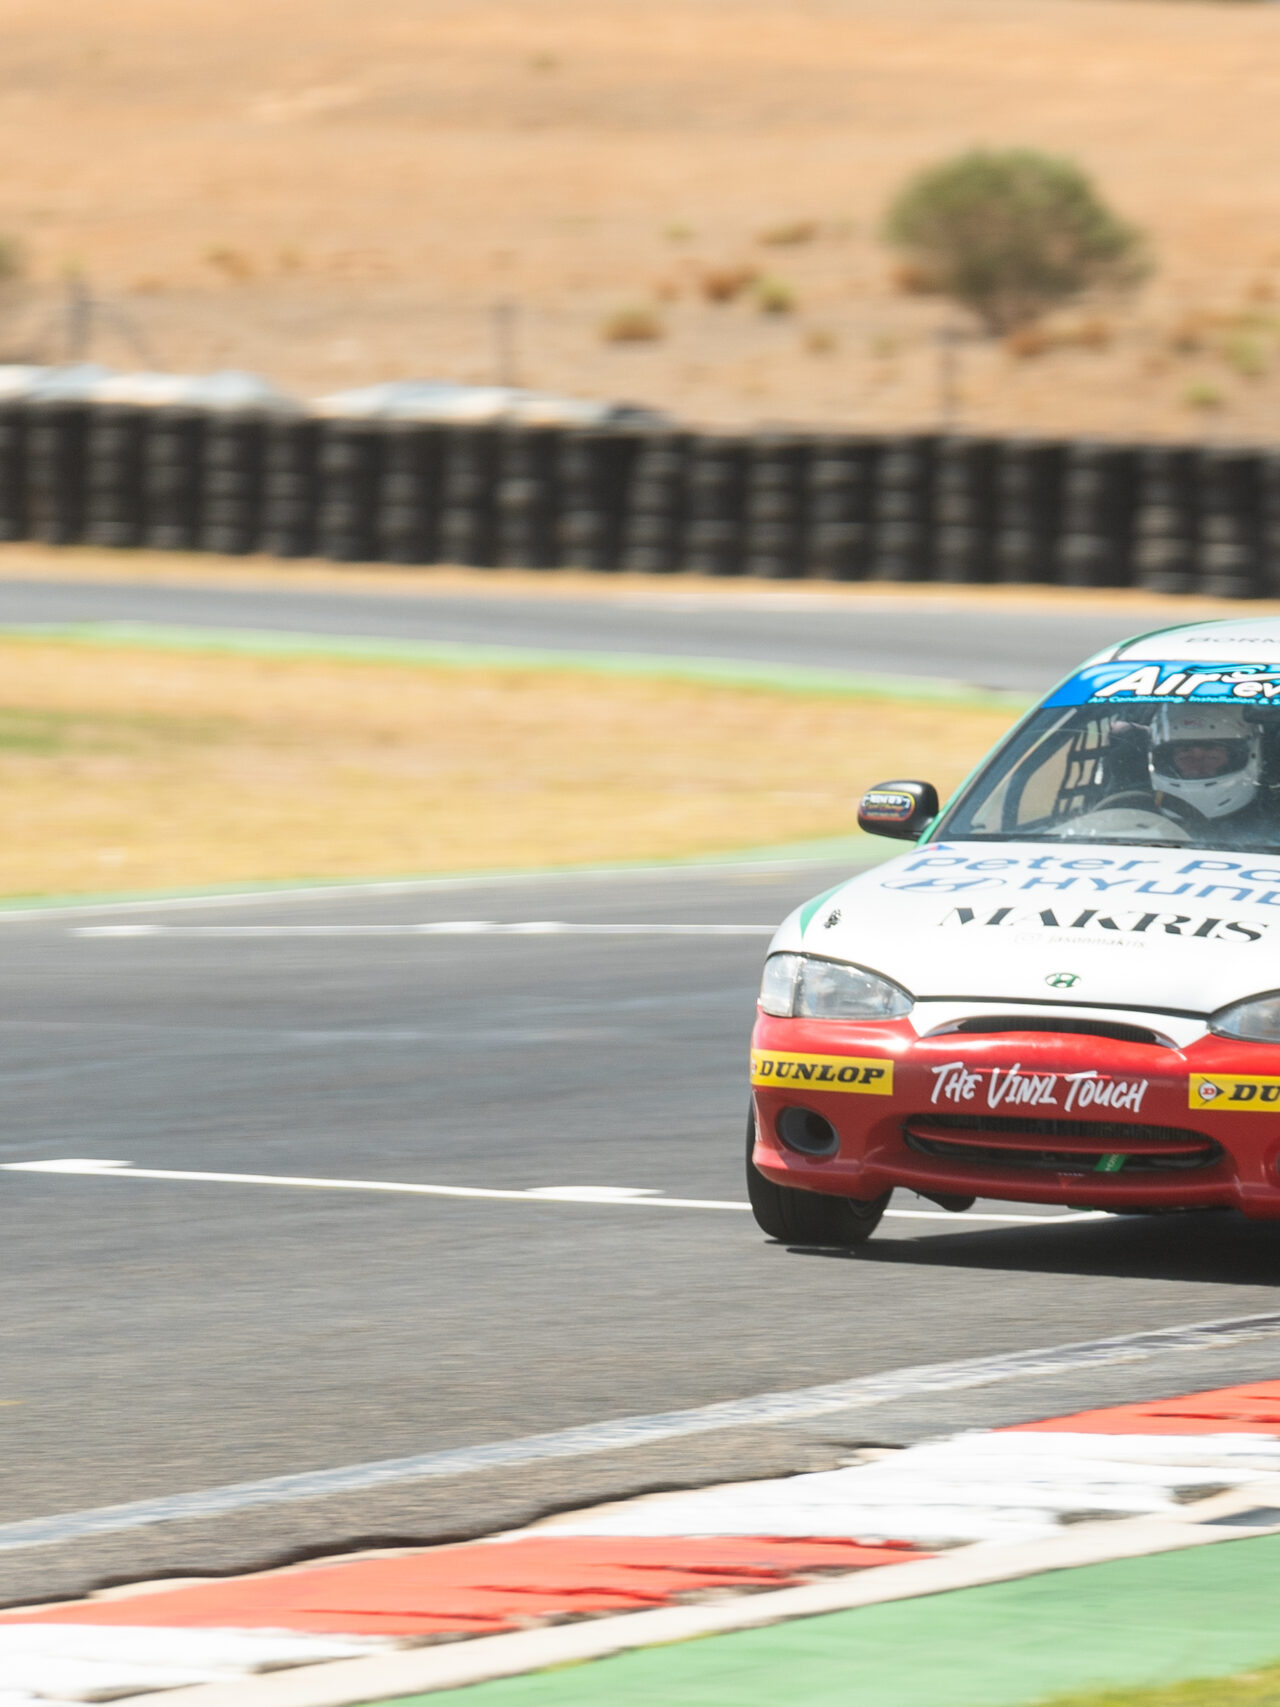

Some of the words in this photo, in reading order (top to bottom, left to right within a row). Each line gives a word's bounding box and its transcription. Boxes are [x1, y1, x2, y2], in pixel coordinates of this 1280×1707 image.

[1094, 665, 1222, 697] Air
[1088, 696, 1104, 704] Air
[1188, 696, 1257, 705] Installation
[904, 855, 1160, 873] Peter
[937, 906, 1270, 942] MAKRIS
[759, 1059, 886, 1085] DUNLOP
[931, 1061, 983, 1104] THE
[987, 1062, 1058, 1109] VINYL
[1064, 1070, 1149, 1112] TOUCH
